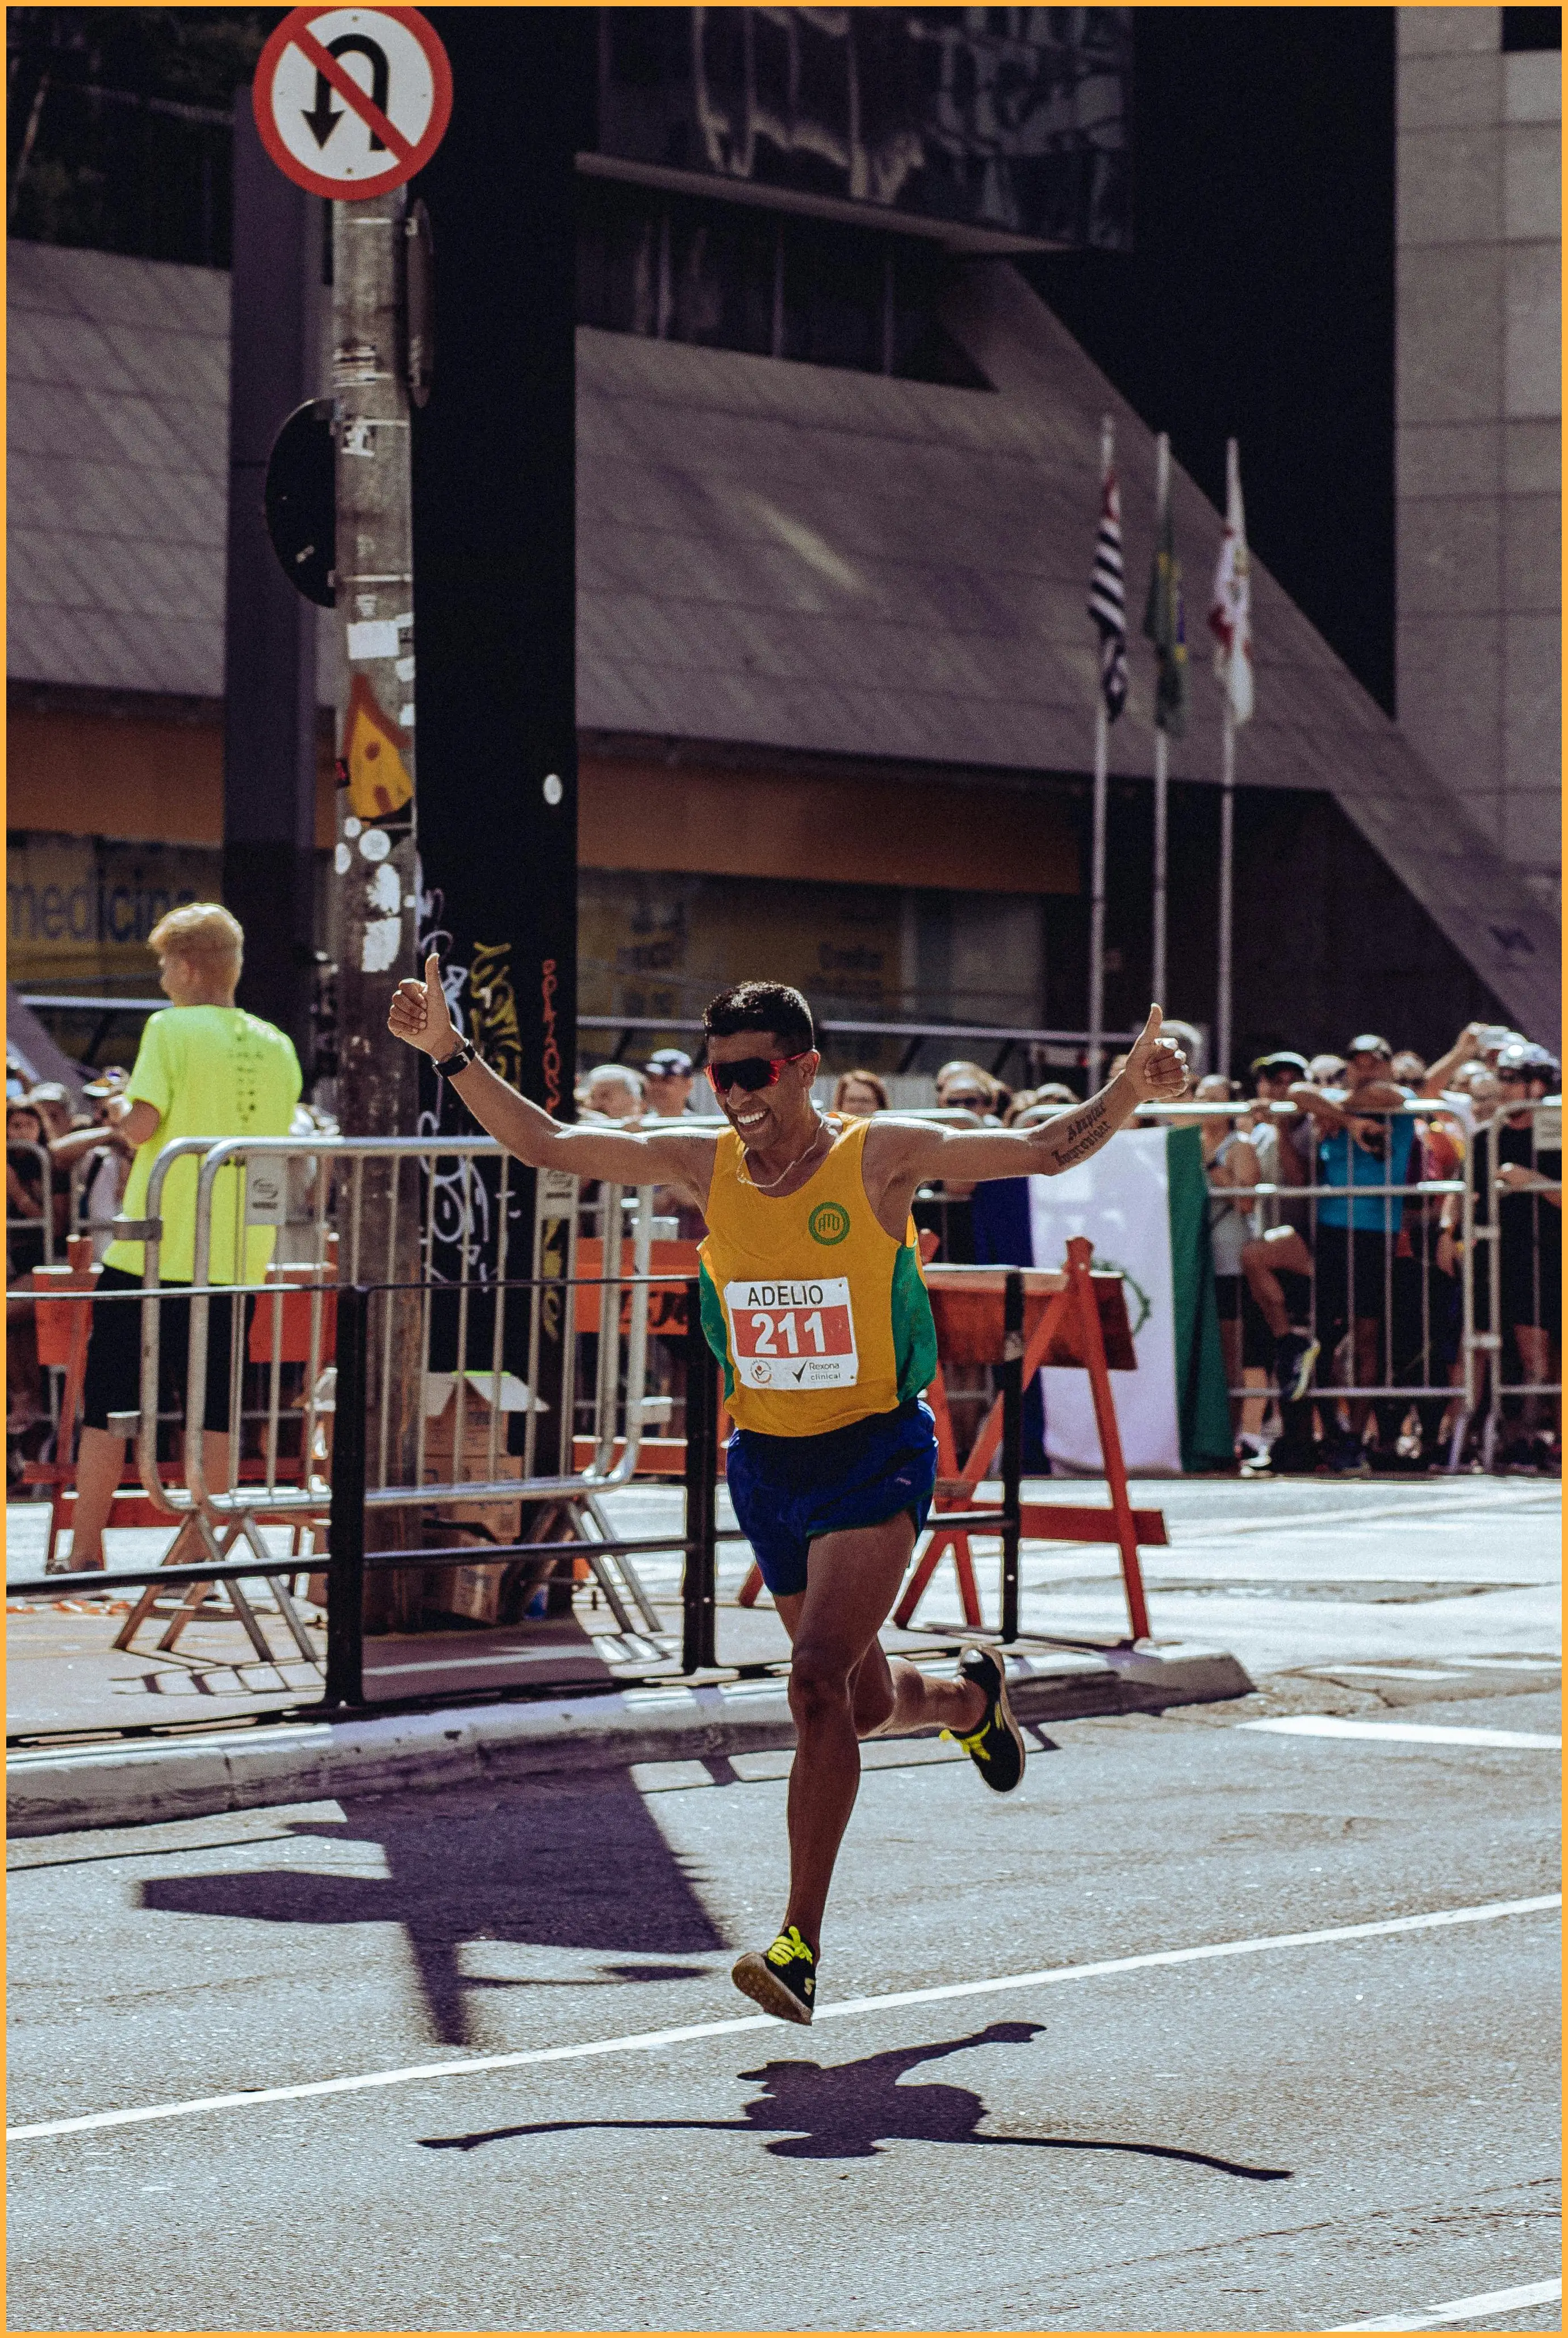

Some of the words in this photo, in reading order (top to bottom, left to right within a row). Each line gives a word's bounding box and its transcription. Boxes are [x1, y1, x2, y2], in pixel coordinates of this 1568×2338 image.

[748, 1285, 823, 1306] ADELIO
[751, 1311, 826, 1355] 211
[809, 1362, 840, 1371] Rexona
